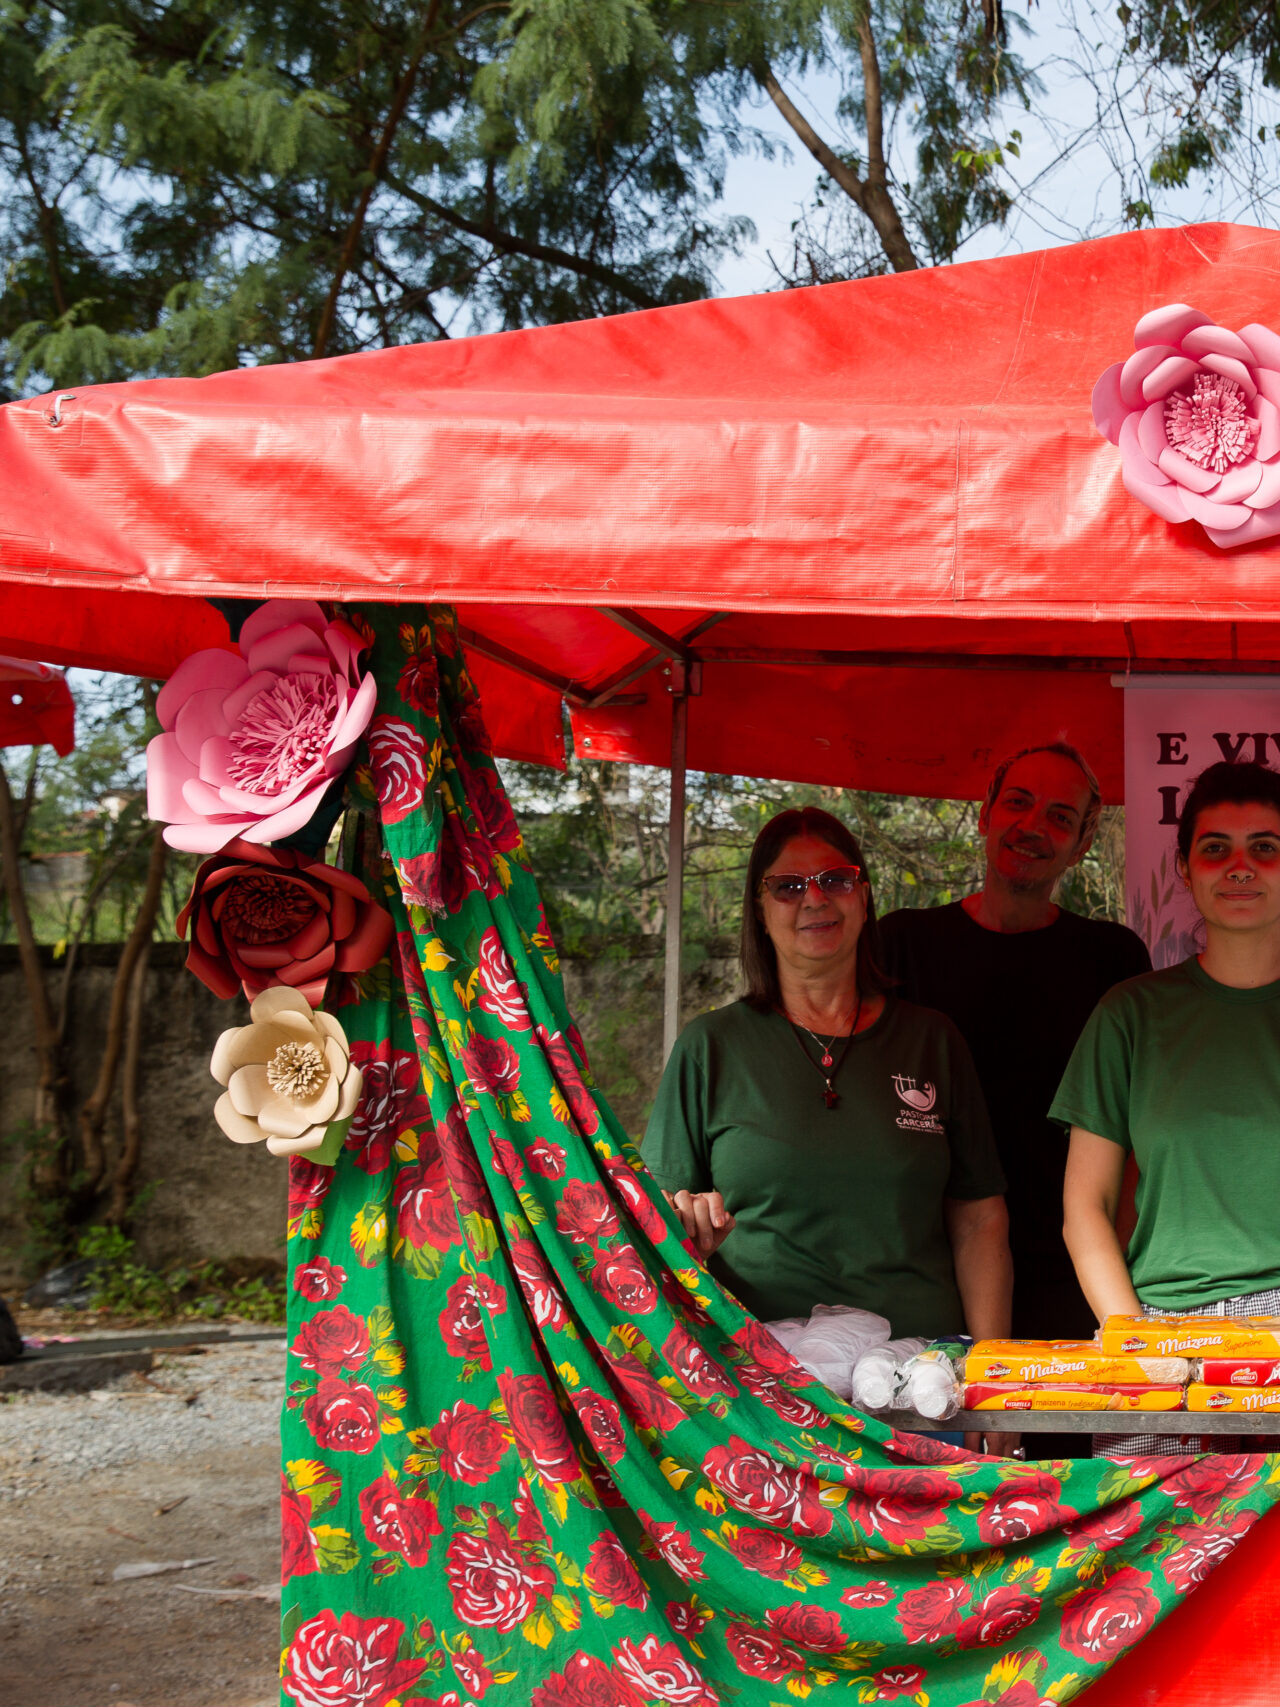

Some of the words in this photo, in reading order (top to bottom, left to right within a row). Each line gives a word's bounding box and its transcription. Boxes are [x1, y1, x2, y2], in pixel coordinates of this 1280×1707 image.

[1157, 733, 1189, 765] E
[1120, 1341, 1148, 1351] Richester
[1156, 1336, 1223, 1355] Maizena
[1019, 1362, 1087, 1381] Maizena
[1206, 1398, 1234, 1408] Richester
